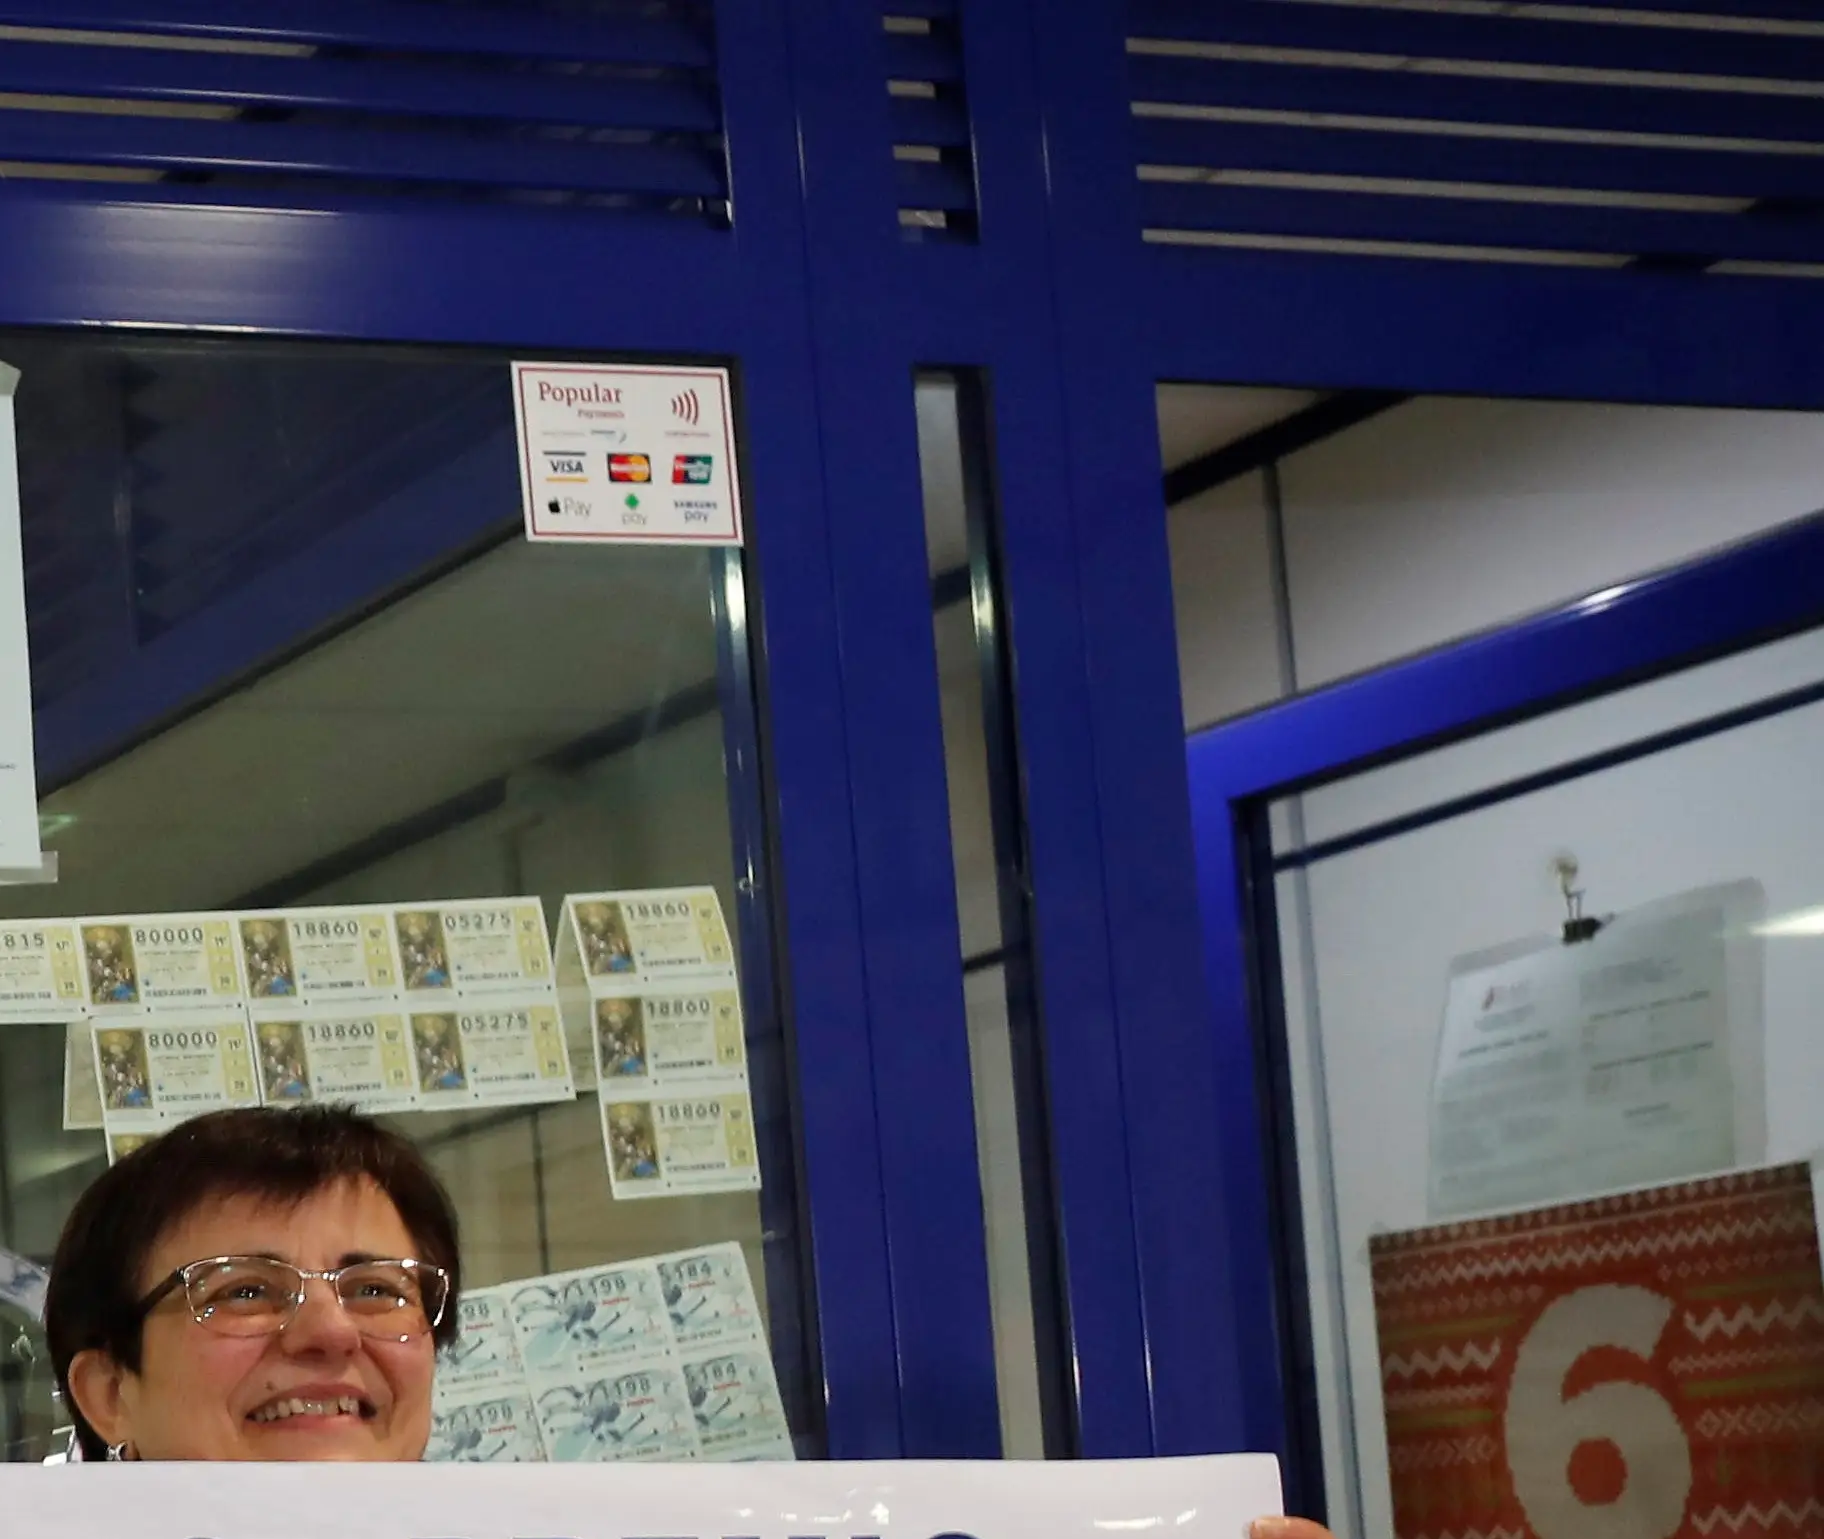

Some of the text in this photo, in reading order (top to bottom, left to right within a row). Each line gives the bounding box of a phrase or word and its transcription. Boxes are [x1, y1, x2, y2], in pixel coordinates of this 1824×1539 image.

[537, 380, 624, 407] Popular
[550, 459, 584, 474] VISA
[564, 497, 592, 518] Pay
[135, 927, 204, 944] 80000
[149, 1031, 217, 1049] 80000
